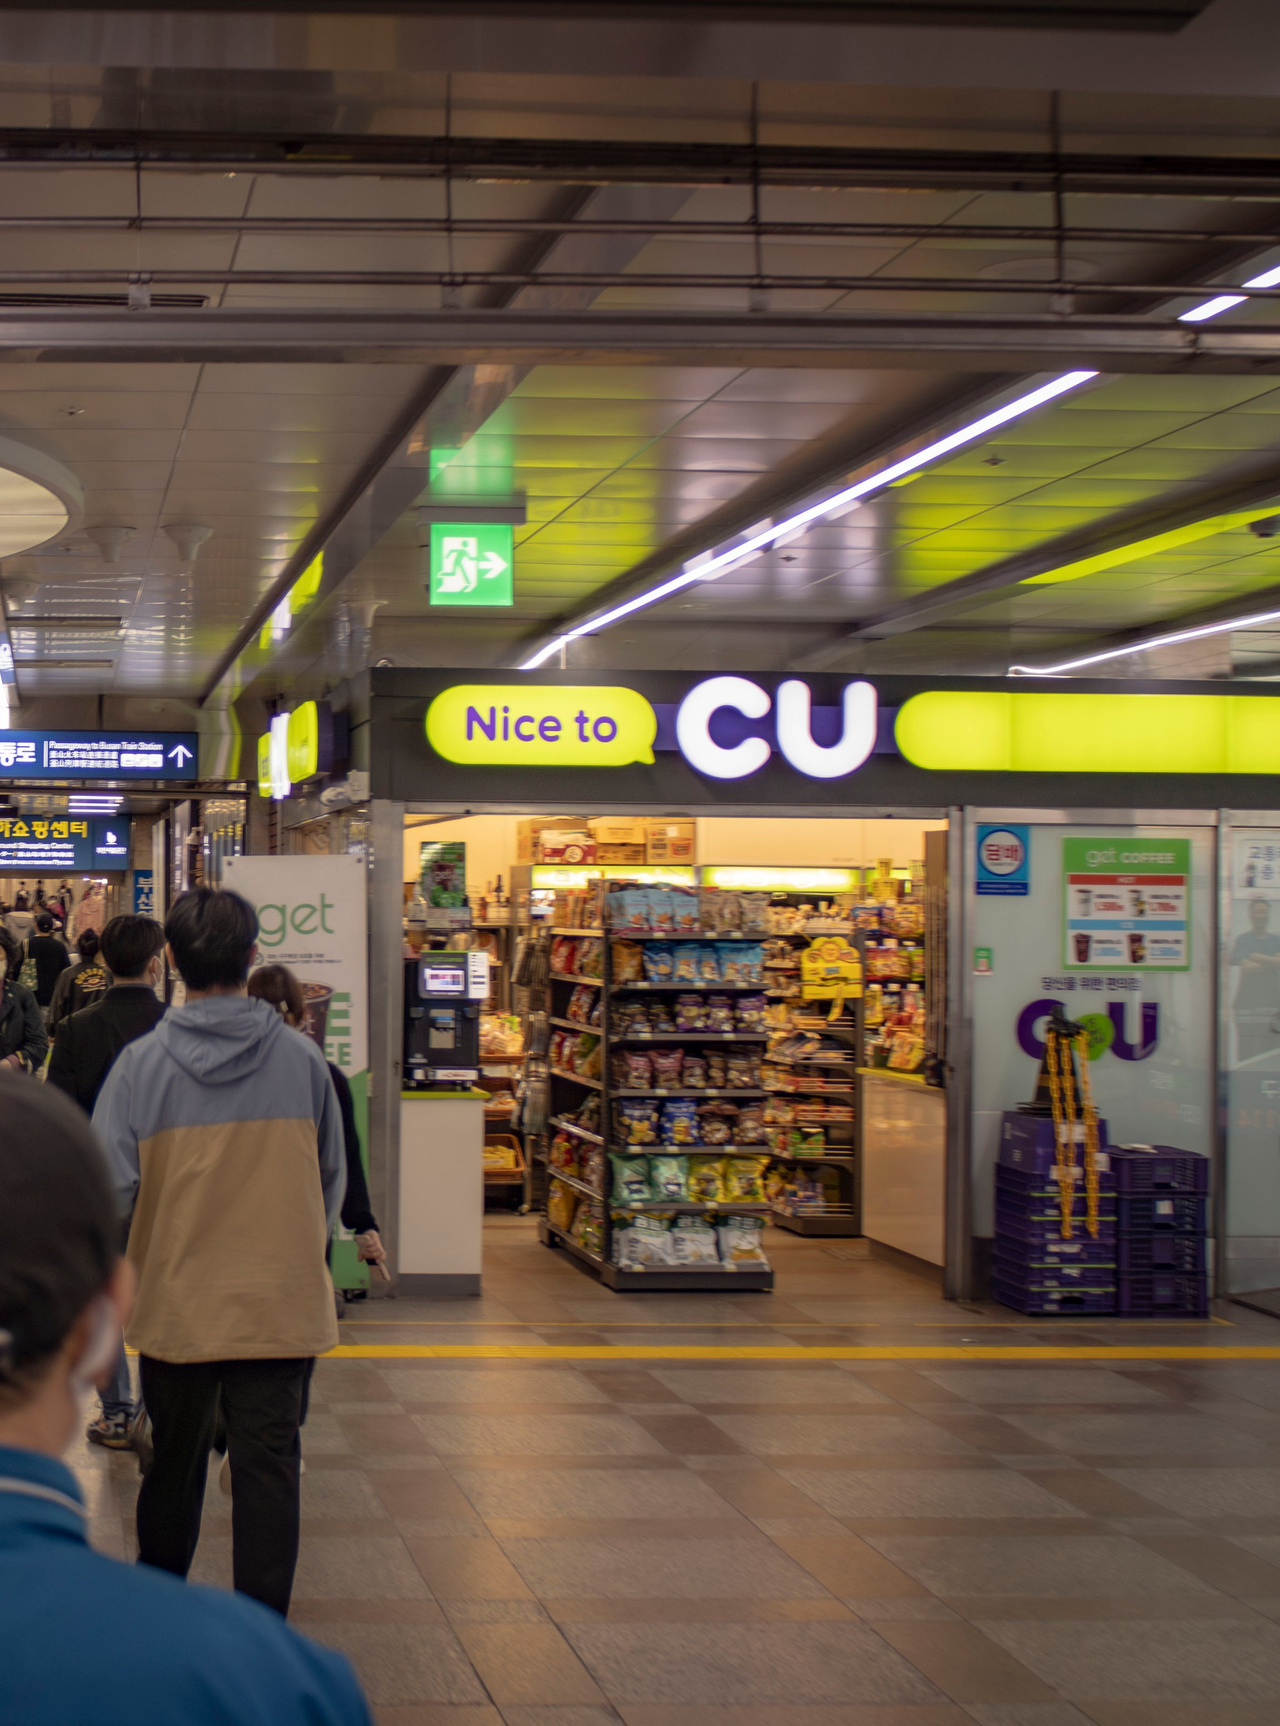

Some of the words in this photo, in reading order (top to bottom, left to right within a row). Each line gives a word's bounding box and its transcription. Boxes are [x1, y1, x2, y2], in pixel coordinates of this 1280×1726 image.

[466, 705, 562, 743] Nice
[574, 709, 618, 743] to
[677, 676, 878, 779] CU
[49, 740, 91, 750] Passageway
[99, 741, 121, 750] Busan
[121, 742, 137, 750] Train
[138, 742, 163, 750] Station
[17, 842, 50, 850] Shopping
[50, 842, 75, 850] Center
[1085, 848, 1118, 867] get
[1120, 852, 1176, 864] COFFEE
[258, 892, 335, 947] get
